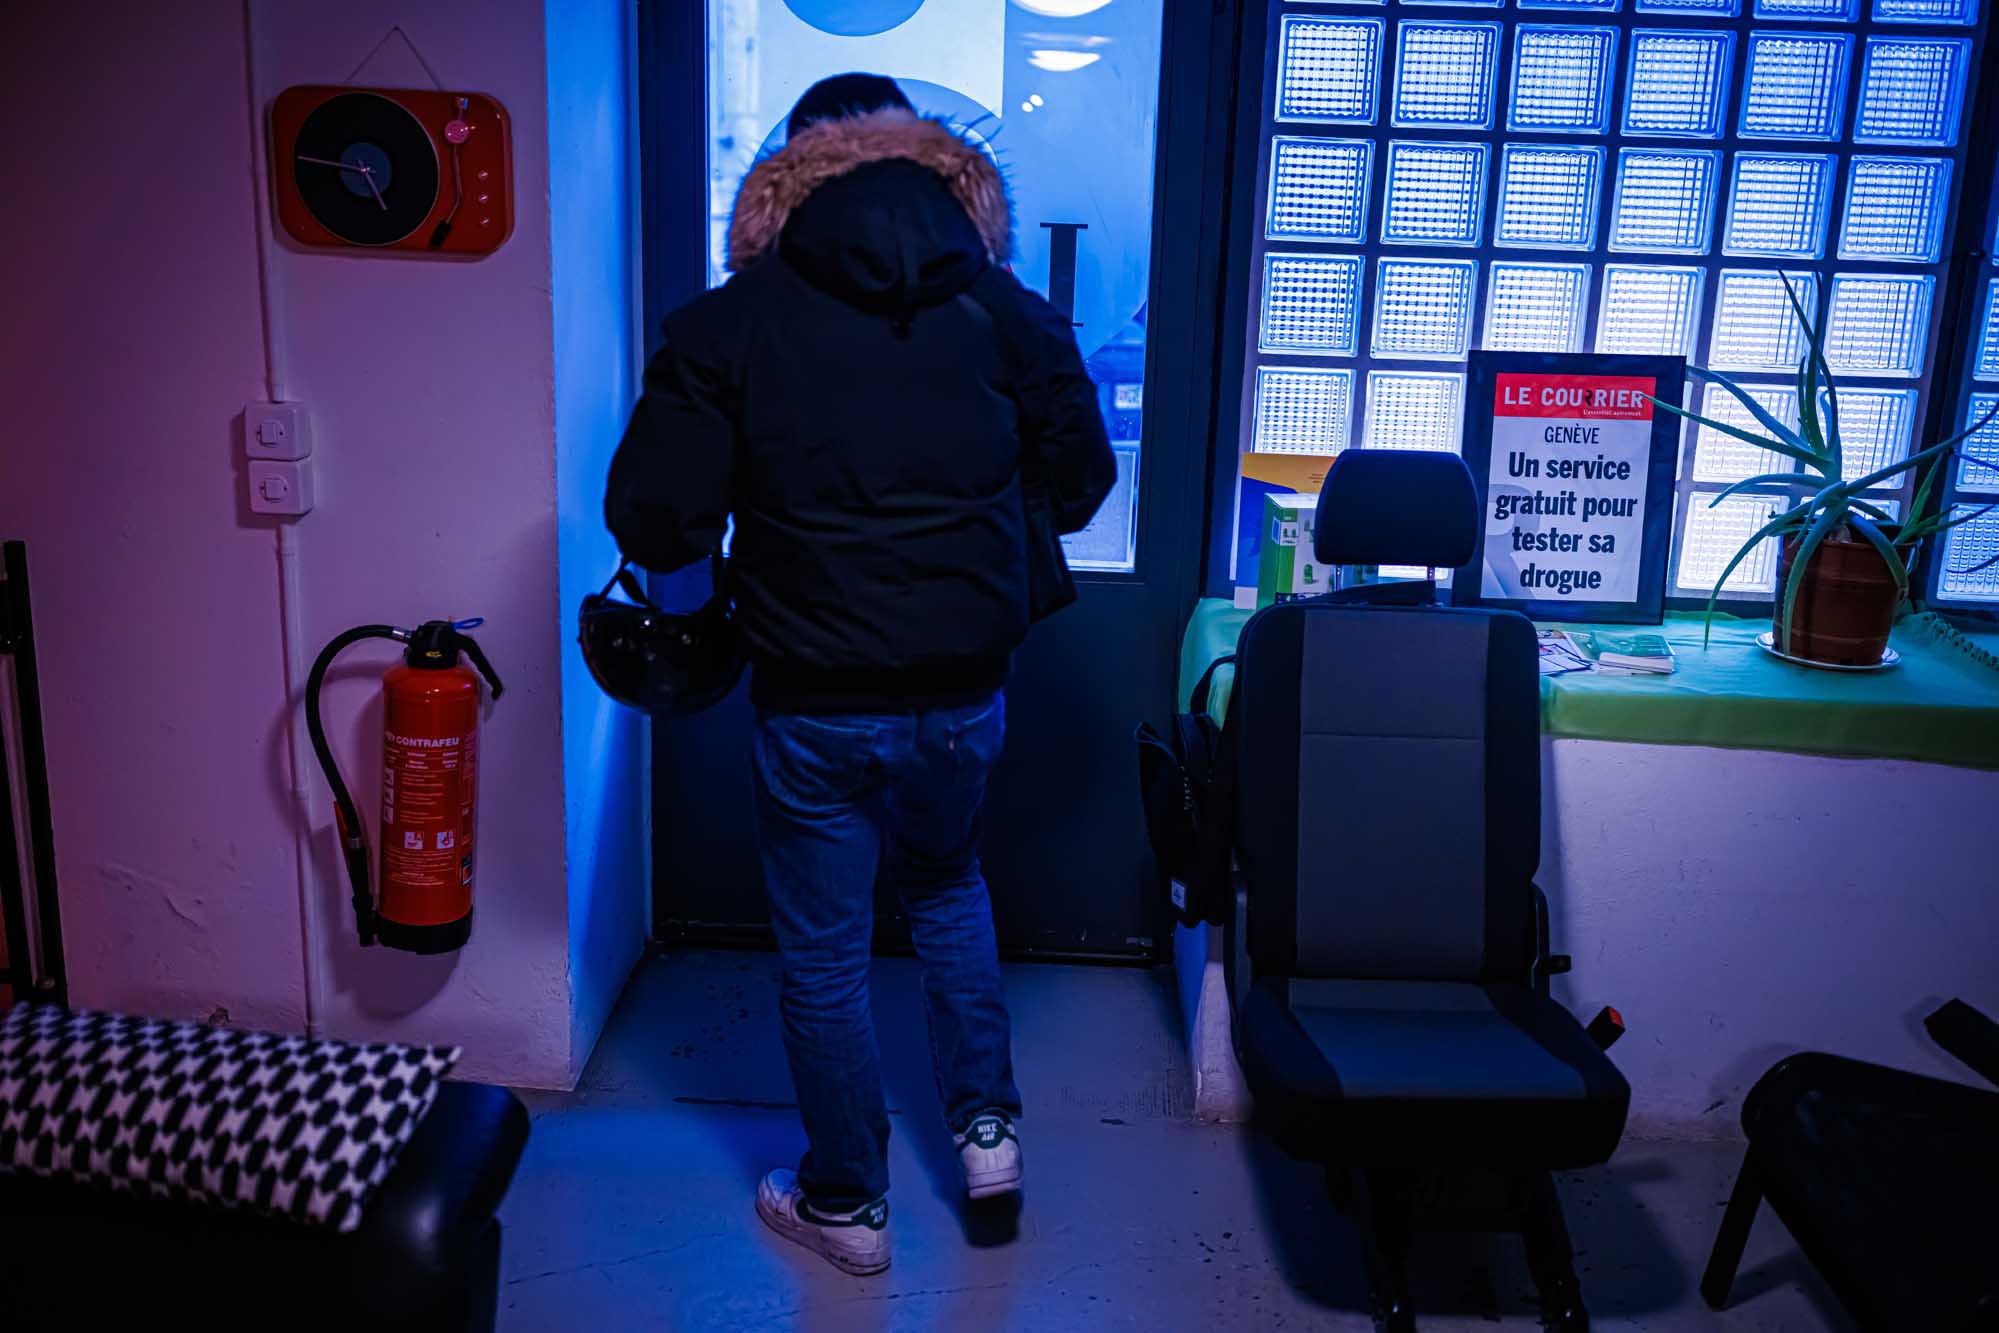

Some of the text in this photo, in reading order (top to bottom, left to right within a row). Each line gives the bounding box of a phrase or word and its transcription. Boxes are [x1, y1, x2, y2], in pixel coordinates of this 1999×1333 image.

[1504, 386, 1643, 408] LE COURRIER
[1544, 423, 1600, 444] GENÈVE
[1508, 452, 1631, 480] Un service
[1494, 490, 1638, 522] gratuit pour
[1512, 526, 1616, 553] tester sa
[1519, 563, 1602, 594] drogue
[395, 736, 460, 748] CONTRAFEU
[978, 1123, 998, 1133] NIKE
